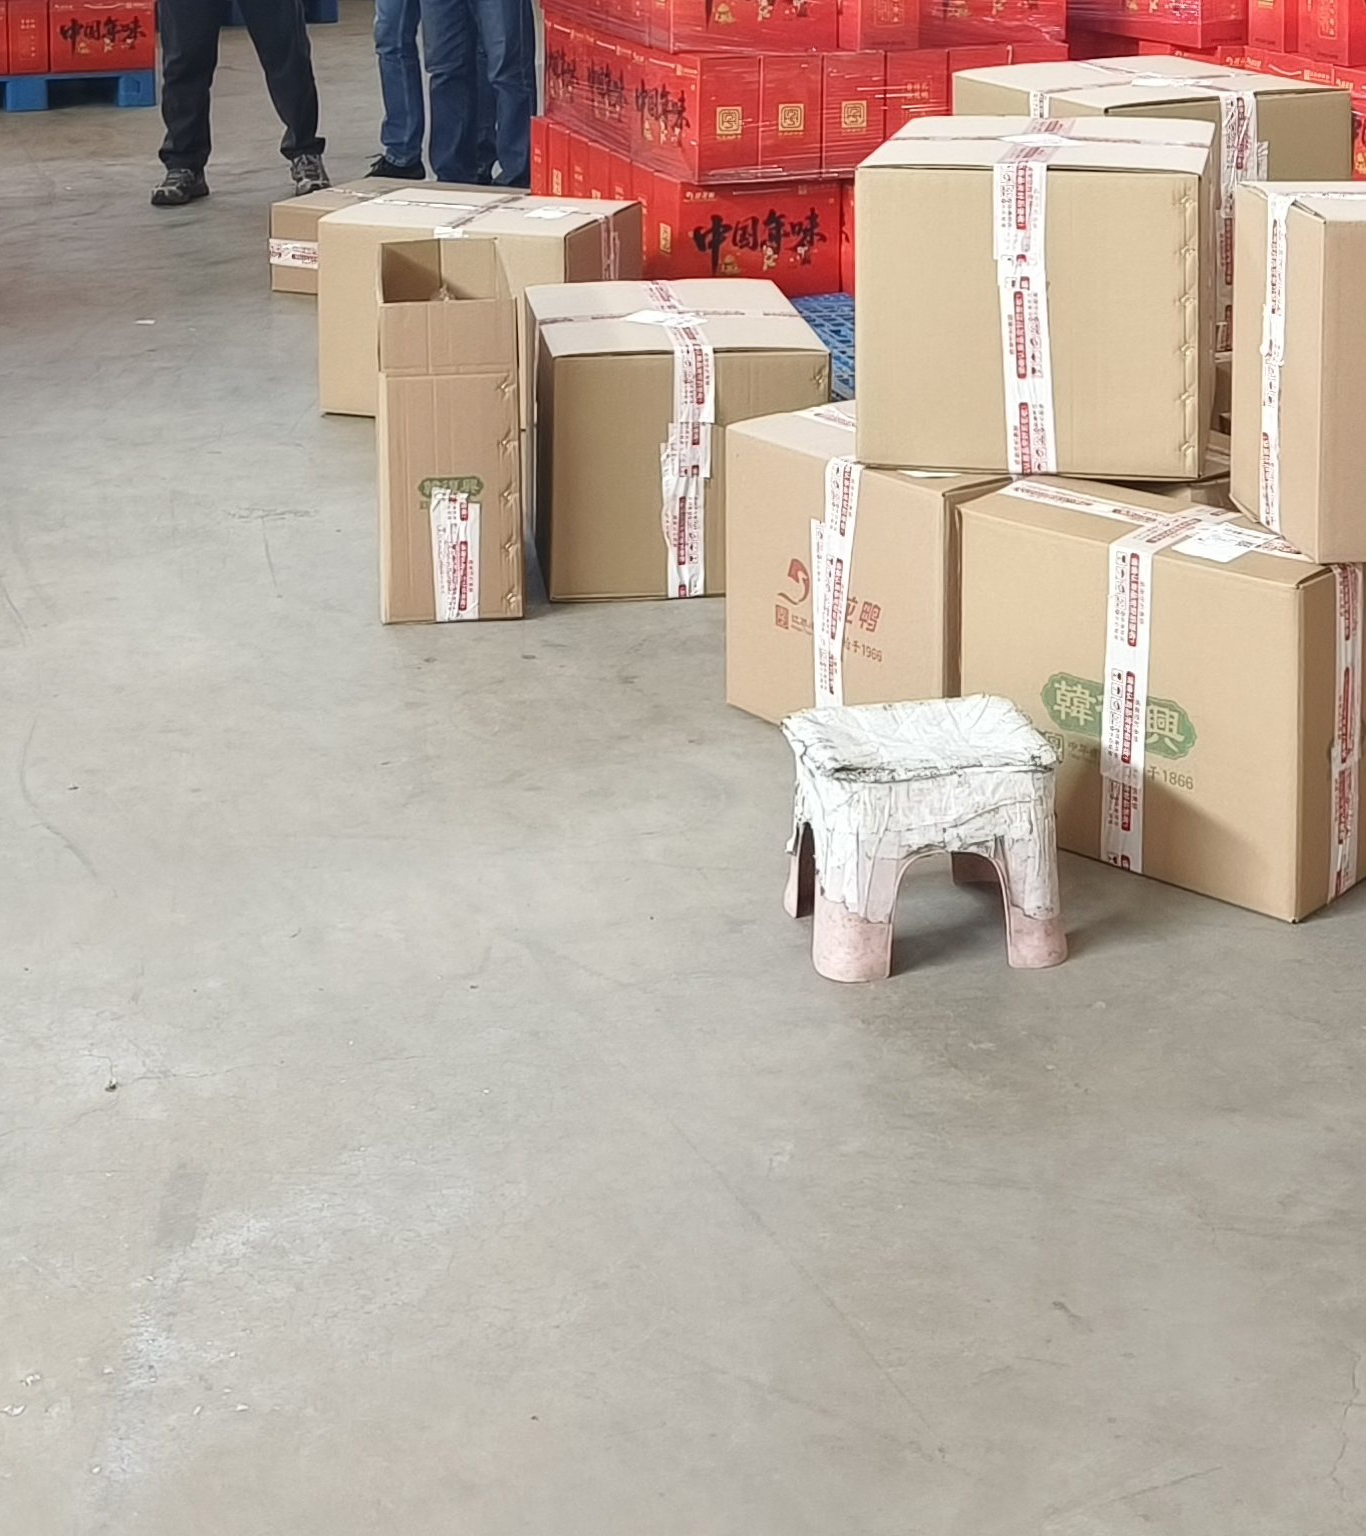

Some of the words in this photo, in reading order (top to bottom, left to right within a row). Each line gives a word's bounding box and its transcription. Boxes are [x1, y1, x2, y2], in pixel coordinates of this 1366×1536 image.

[60, 16, 146, 60] 中国年味
[694, 208, 827, 276] 中国年味
[1054, 680, 1185, 754] 韓興
[1147, 766, 1194, 790] 于1866
